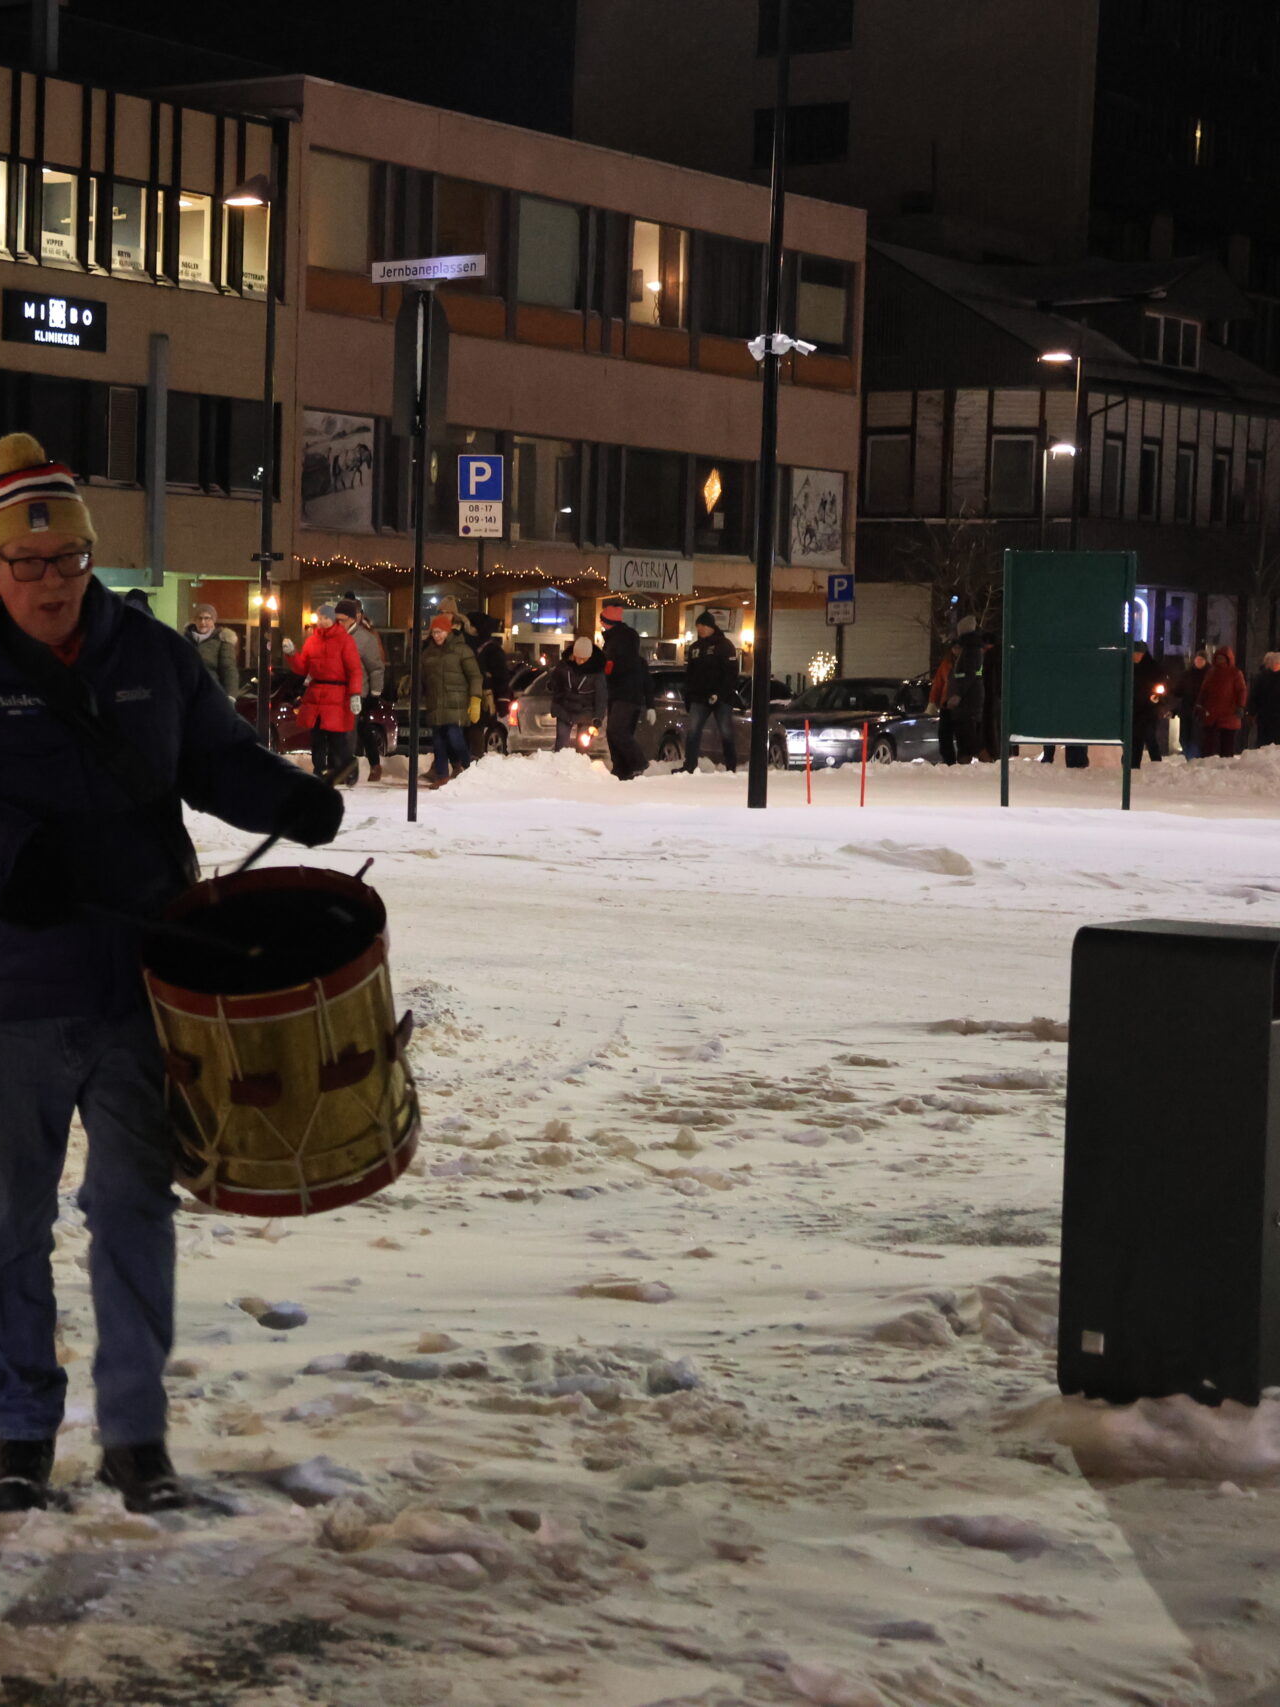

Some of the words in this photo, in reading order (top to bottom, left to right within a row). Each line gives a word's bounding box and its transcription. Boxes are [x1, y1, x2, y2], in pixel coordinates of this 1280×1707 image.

[46, 238, 64, 247] VIPPER
[380, 262, 477, 279] Jernbaneplassen
[34, 329, 80, 346] KLINIKKEN
[469, 461, 492, 496] P
[623, 560, 679, 590] CASTRUM
[833, 577, 848, 600] P
